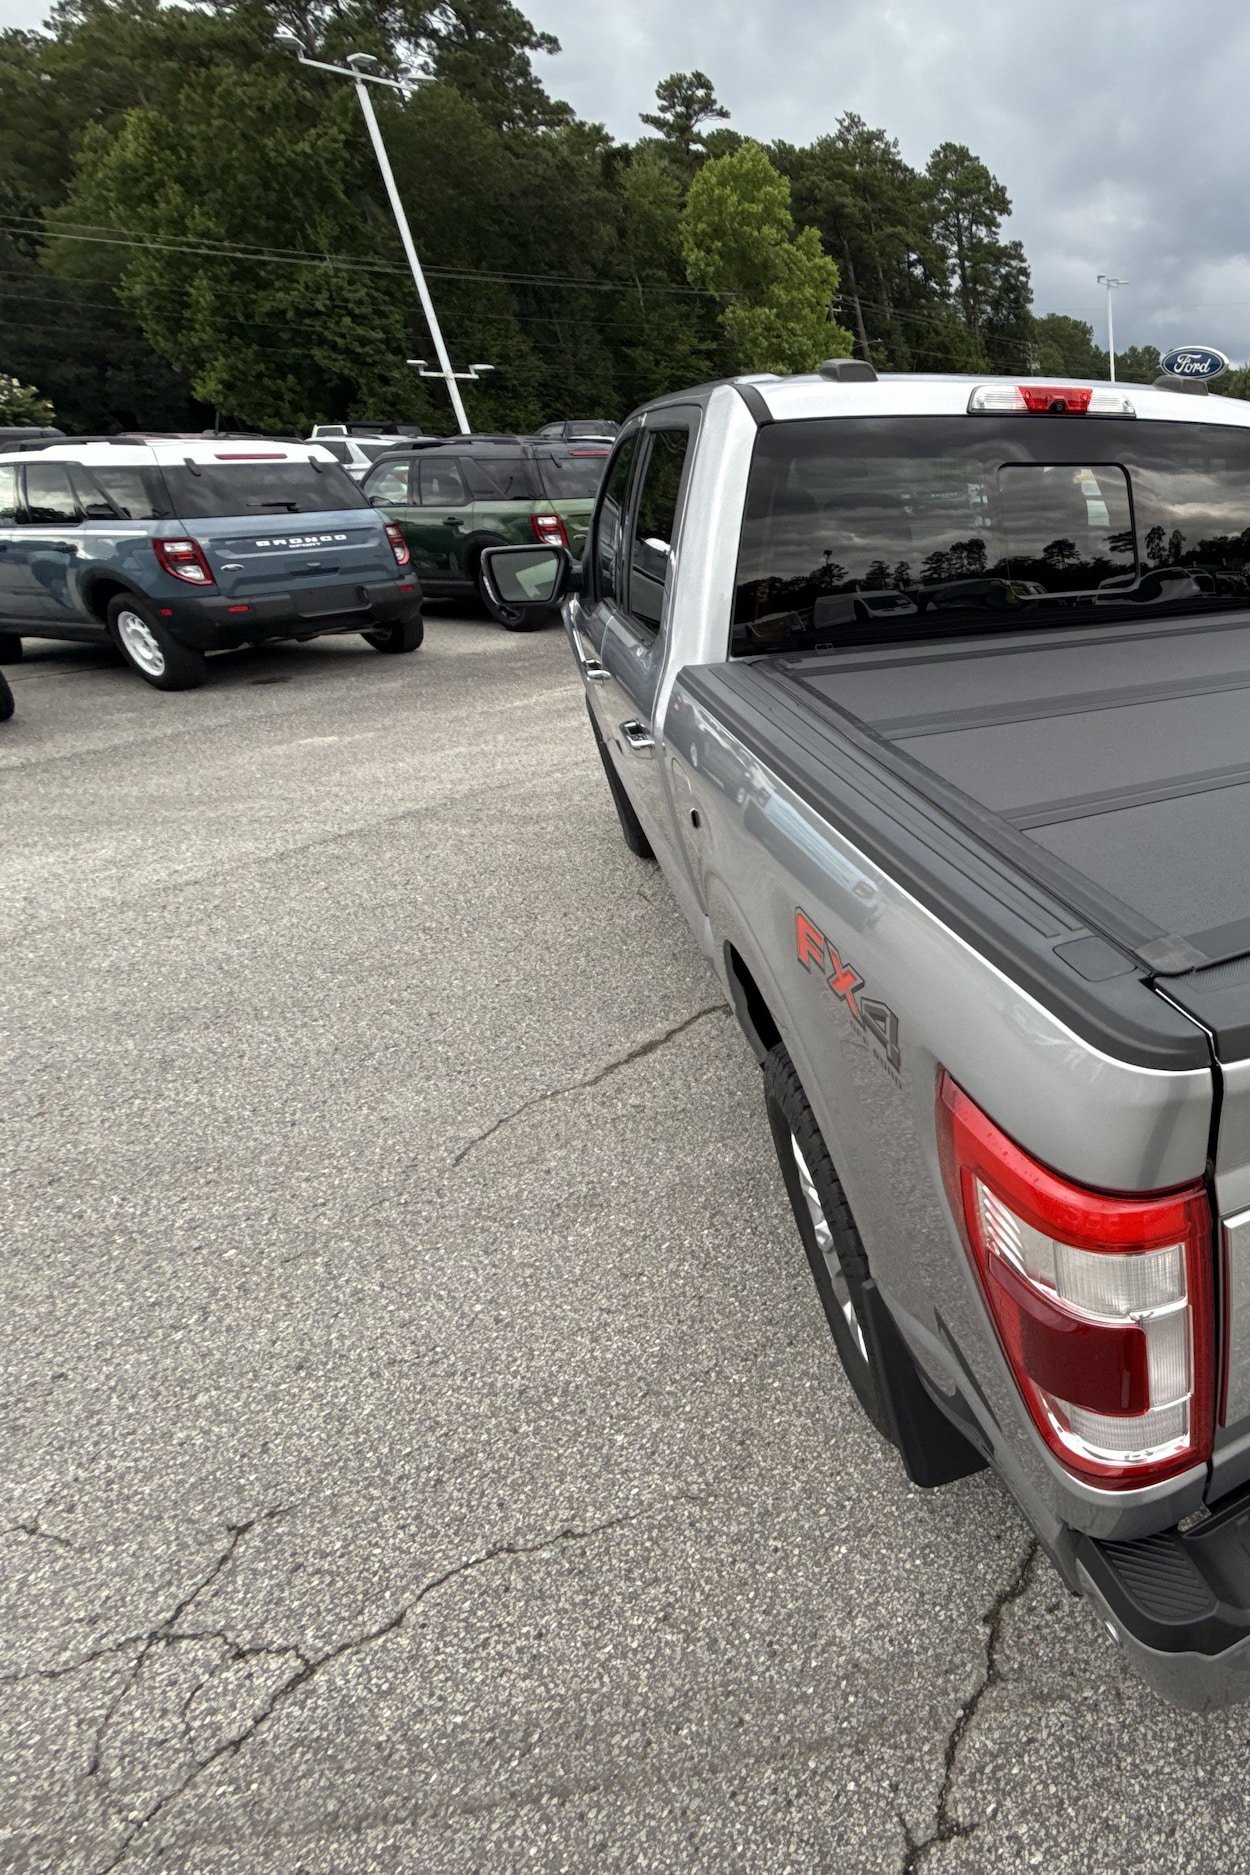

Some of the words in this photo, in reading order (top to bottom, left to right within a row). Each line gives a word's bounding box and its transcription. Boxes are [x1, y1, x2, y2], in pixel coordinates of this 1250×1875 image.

[1173, 353, 1212, 373] Ford
[255, 534, 347, 547] BRONCO
[795, 906, 901, 1074] FX4
